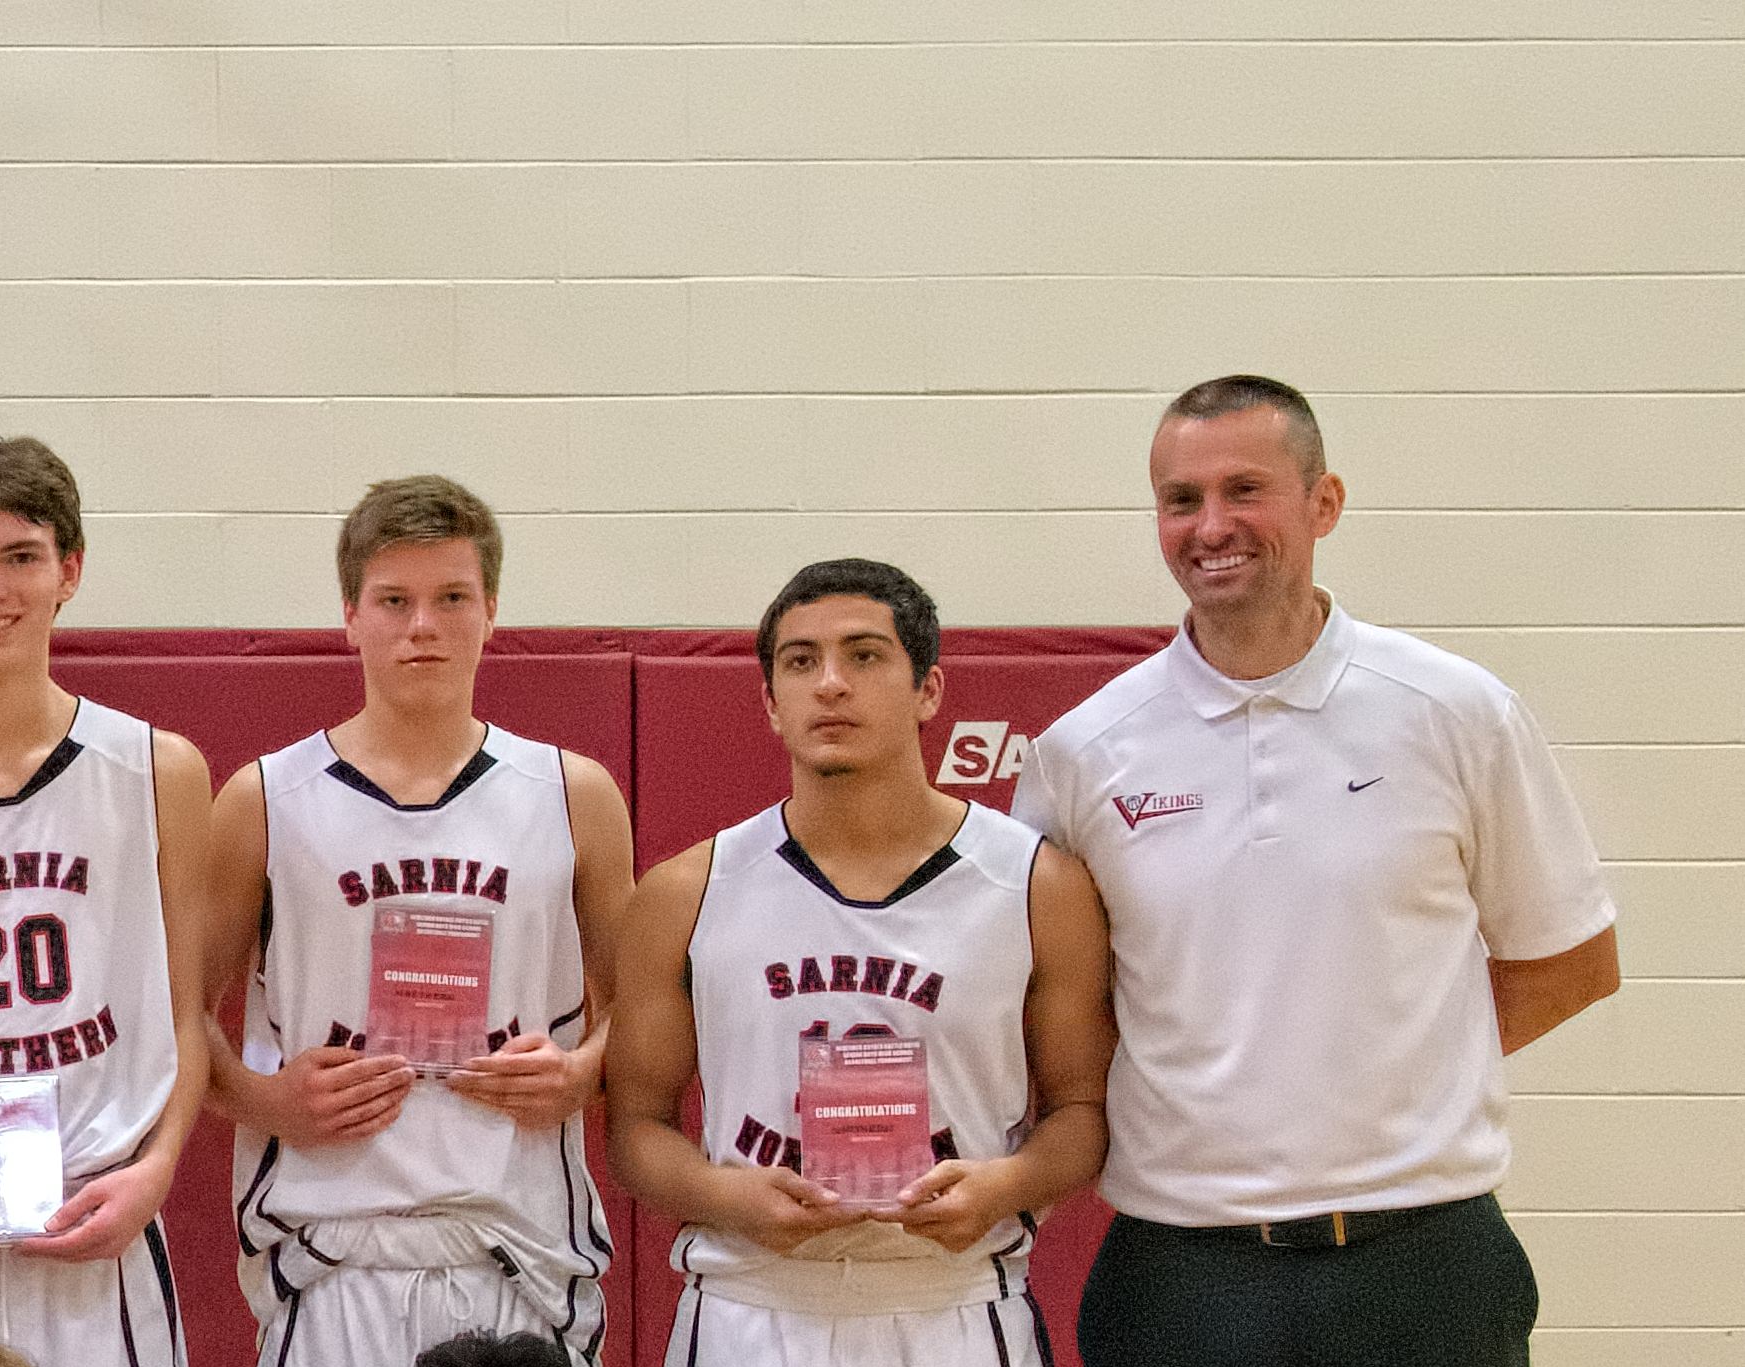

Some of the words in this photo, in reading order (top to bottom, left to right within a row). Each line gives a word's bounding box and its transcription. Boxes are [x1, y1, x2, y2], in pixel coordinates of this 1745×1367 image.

[1112, 793, 1204, 830] VIKINGS
[338, 858, 509, 907] SARNIA
[384, 970, 479, 987] CONGRATULATIONS
[764, 955, 944, 1013] SARNIA
[815, 1103, 916, 1118] CONGRATULATIONS
